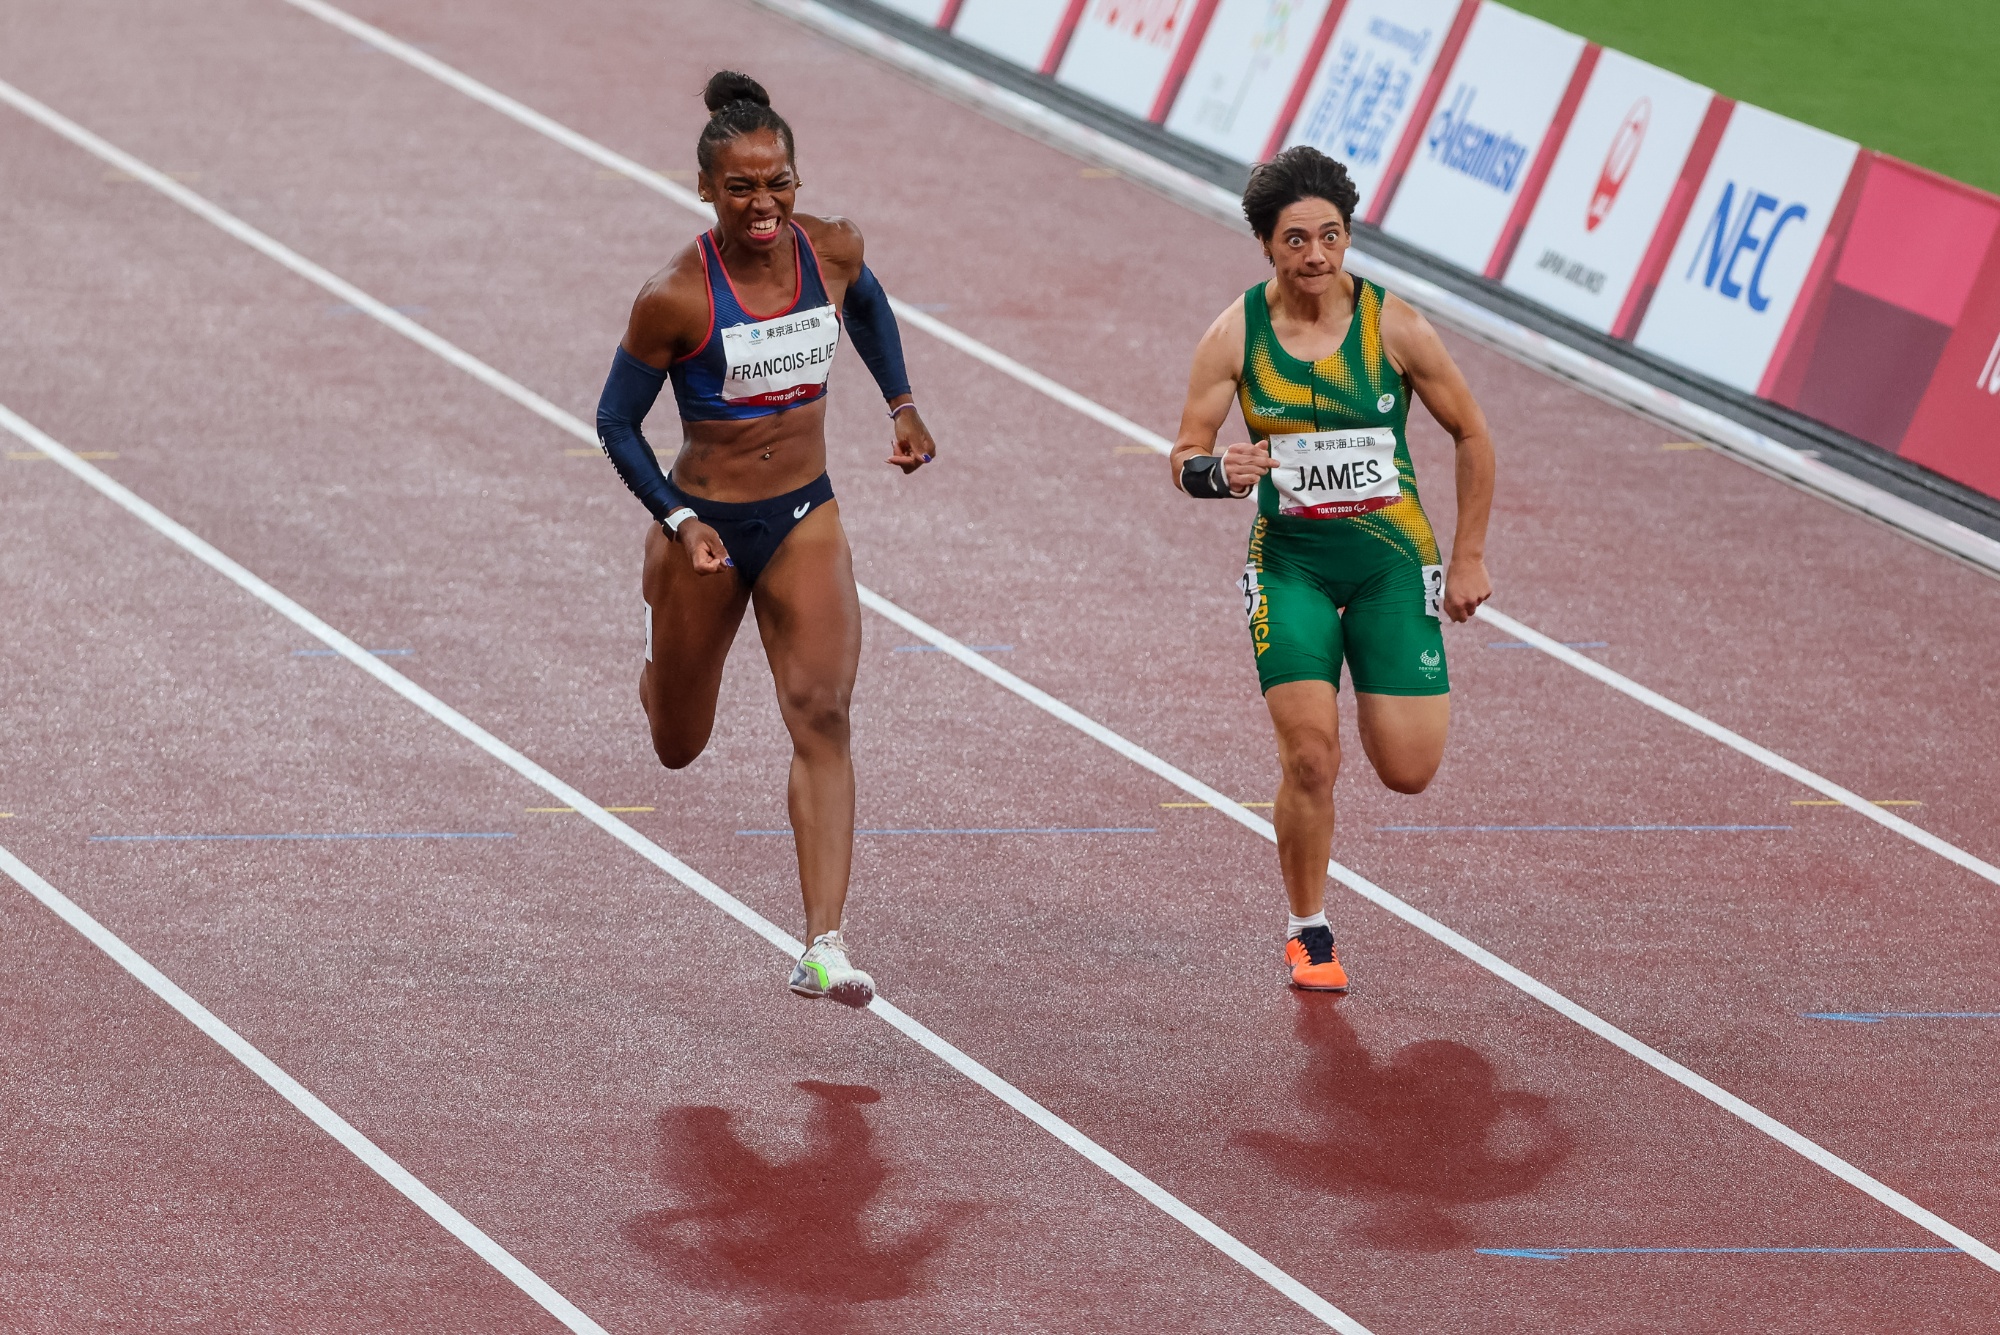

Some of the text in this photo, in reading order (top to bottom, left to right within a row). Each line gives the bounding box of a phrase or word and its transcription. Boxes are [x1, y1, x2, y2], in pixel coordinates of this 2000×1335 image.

[1686, 182, 1808, 312] NEC
[766, 317, 820, 339] 東京海上日動
[732, 342, 835, 380] FRANCOIS-ELIE
[765, 394, 785, 402] TOKYO
[1314, 435, 1376, 451] 東京海上日動
[1292, 459, 1382, 492] JAMES
[1317, 505, 1353, 515] TOKYO 2020
[1242, 572, 1254, 617] 3
[1252, 584, 1271, 658] RICA
